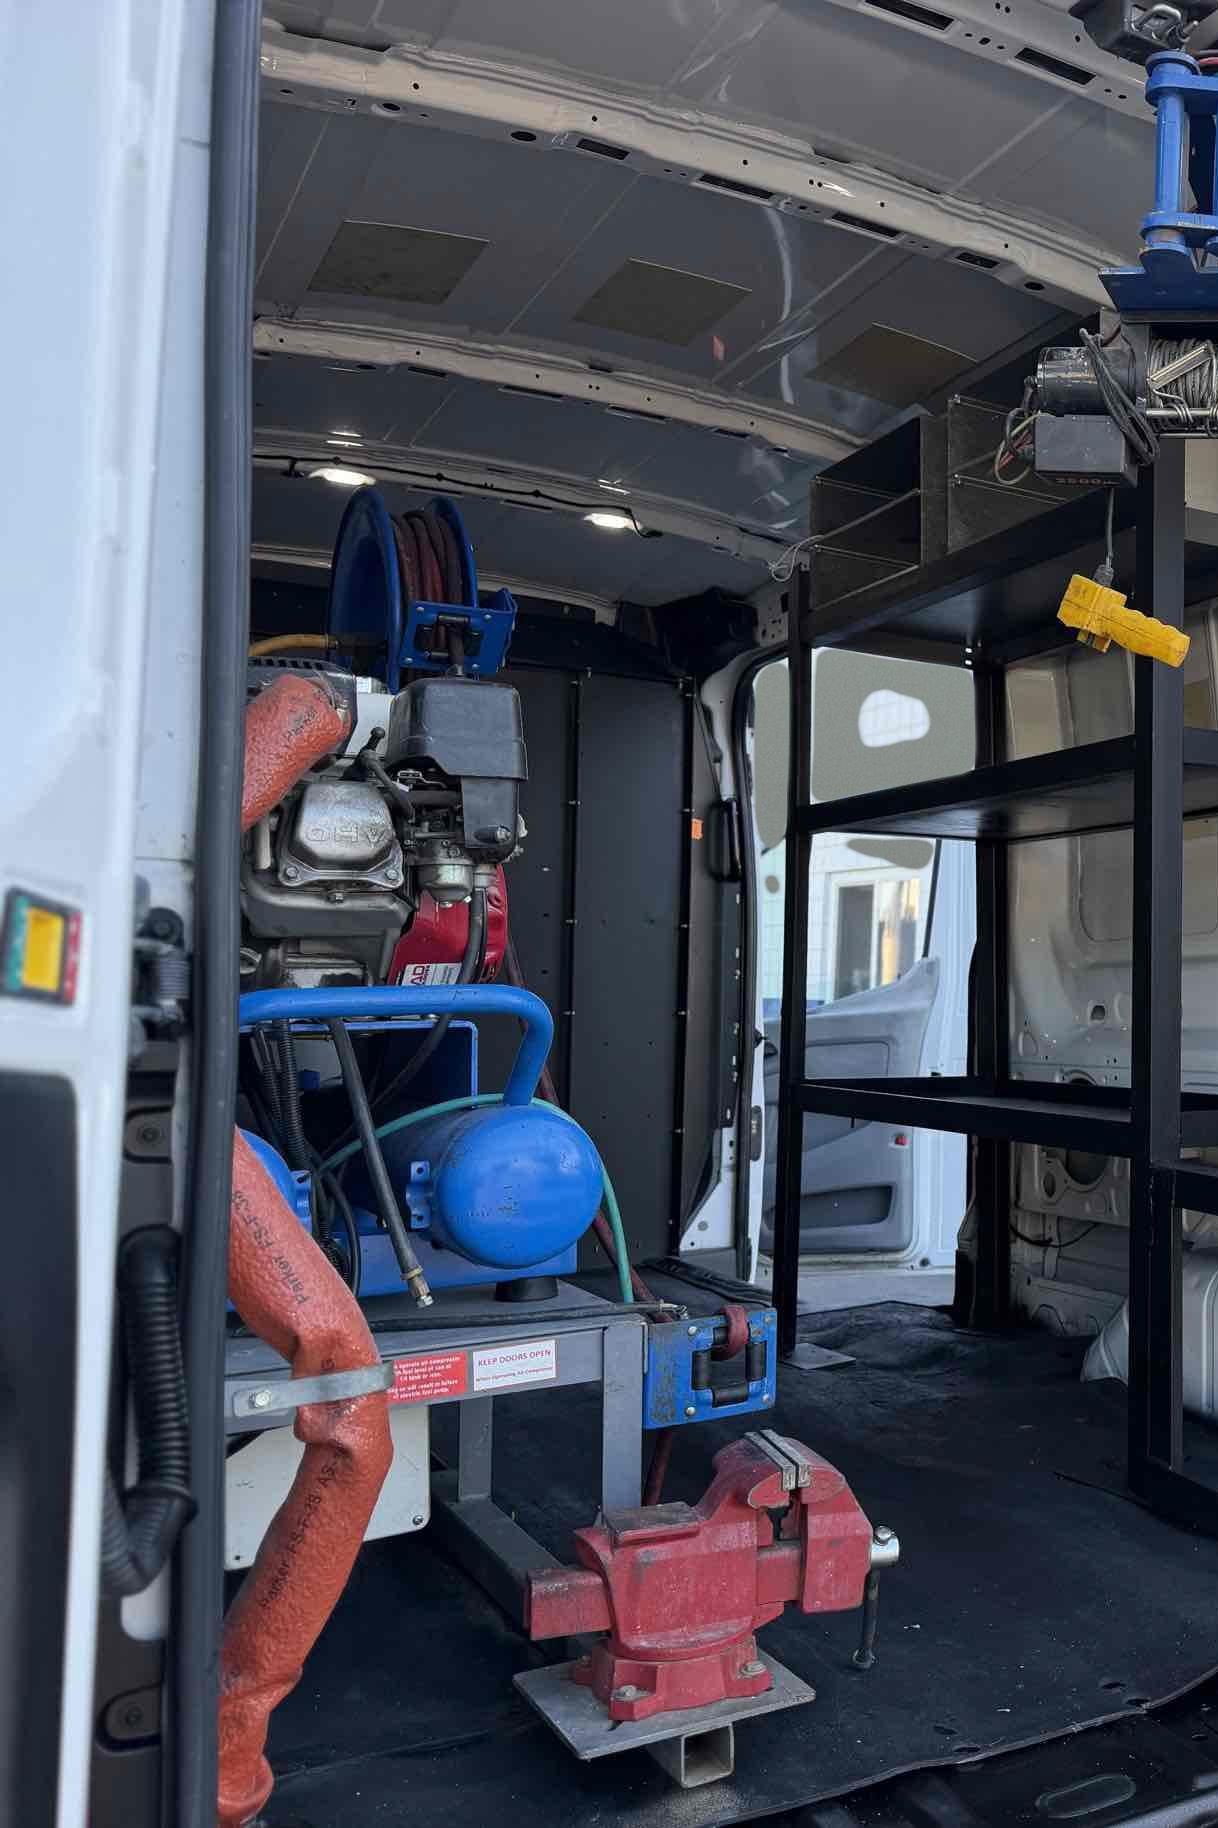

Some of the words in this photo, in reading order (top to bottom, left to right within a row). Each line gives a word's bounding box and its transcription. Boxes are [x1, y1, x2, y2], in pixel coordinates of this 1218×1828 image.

[272, 1255, 310, 1304] Parker
[478, 1357, 498, 1367] KEEP
[499, 1353, 528, 1364] DOORS
[529, 1349, 552, 1360] OPEN
[259, 1559, 289, 1608] Parker
